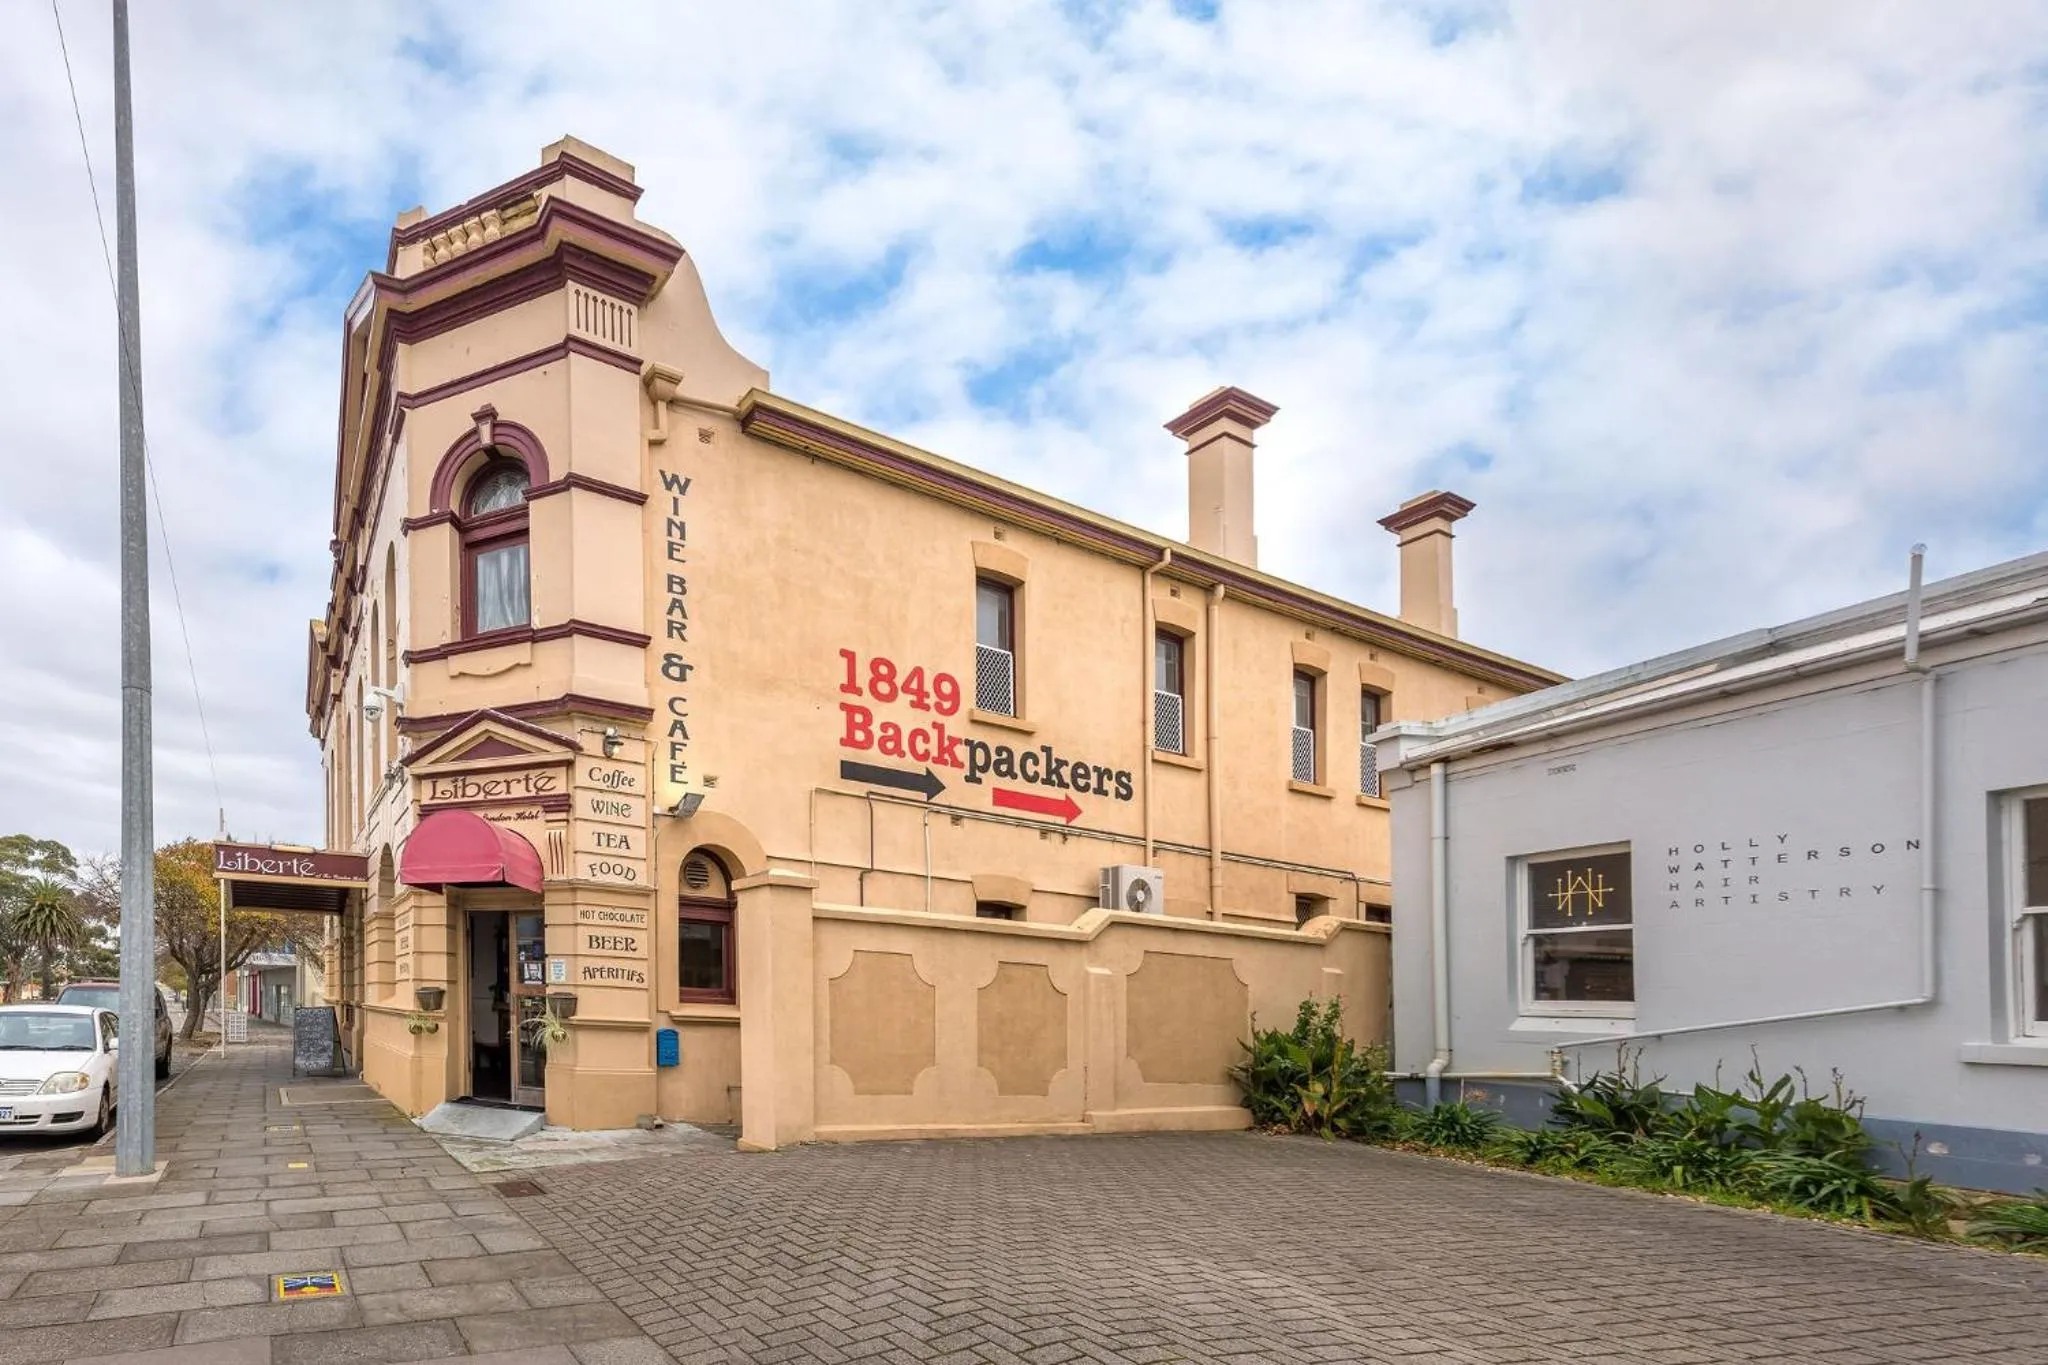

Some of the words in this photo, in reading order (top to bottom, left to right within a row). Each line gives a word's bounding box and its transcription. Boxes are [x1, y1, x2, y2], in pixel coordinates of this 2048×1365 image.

[659, 469, 692, 563] WINE
[666, 573, 688, 642] BAR
[661, 653, 693, 683] &
[839, 648, 961, 717] 1849
[839, 702, 1134, 801] Backpackers
[429, 771, 557, 800] Liberté
[588, 766, 636, 789] Coffee
[513, 810, 540, 821] Hotel
[592, 831, 631, 851] TEA
[1668, 833, 1788, 857] HOLLY
[217, 850, 316, 877] Liberté
[1667, 839, 1920, 875] WATTERSON
[588, 861, 637, 882] FOOD
[1669, 875, 1760, 892] HAIR
[1669, 884, 1886, 910] ARTISTRY
[580, 910, 595, 920] HOT
[597, 911, 646, 924] CHOCOLATE
[586, 934, 638, 953] BEER
